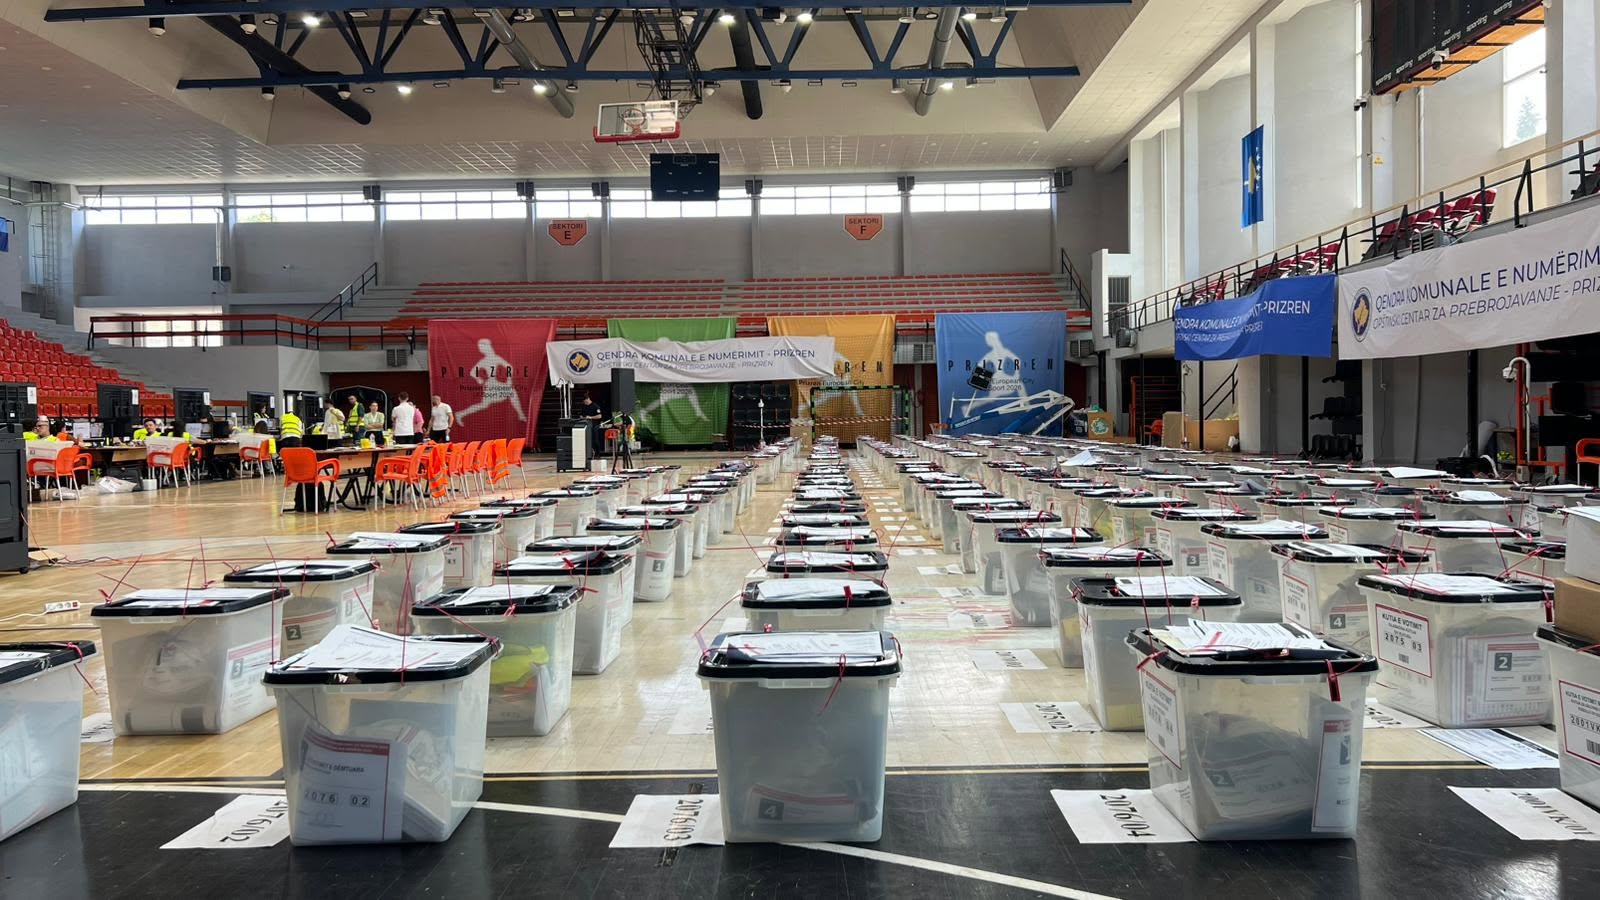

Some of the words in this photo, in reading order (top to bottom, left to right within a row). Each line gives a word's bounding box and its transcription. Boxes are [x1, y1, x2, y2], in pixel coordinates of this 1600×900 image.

[1467, 14, 1488, 32] sporting
[1441, 30, 1462, 46] sporting
[1396, 60, 1413, 74] sporting
[1375, 72, 1392, 86] sporting
[552, 222, 584, 230] SEKTORI
[848, 217, 879, 225] SEKTORI
[564, 230, 572, 240] E
[860, 225, 867, 235] F
[1375, 289, 1405, 313] QENDRA
[1405, 271, 1491, 303] KOMUNALE
[1497, 268, 1508, 288] E
[1401, 309, 1431, 326] CENTAR
[1432, 306, 1447, 321] ZA
[1449, 284, 1561, 318] PREBROJAVANJE
[596, 350, 639, 361] QENDRA
[641, 352, 697, 363] KOMUNALE
[699, 353, 705, 362] E
[708, 349, 765, 361] NUMERIMIT
[773, 348, 815, 358] PRIZREN
[742, 360, 774, 368] PRIZREN
[947, 357, 1054, 372] PRIZREN
[1333, 617, 1343, 628] 4
[1382, 613, 1397, 622] KUTIA
[1397, 617, 1402, 625] E
[1402, 618, 1423, 631] VOTIMIT
[289, 628, 299, 639] 2
[1384, 632, 1405, 646] 2075
[1412, 641, 1423, 652] 03
[1498, 656, 1509, 669] 2
[351, 795, 370, 807] 02
[764, 804, 778, 818] 4
[1099, 794, 1157, 837] 2076/04
[663, 799, 704, 841] 2076/03
